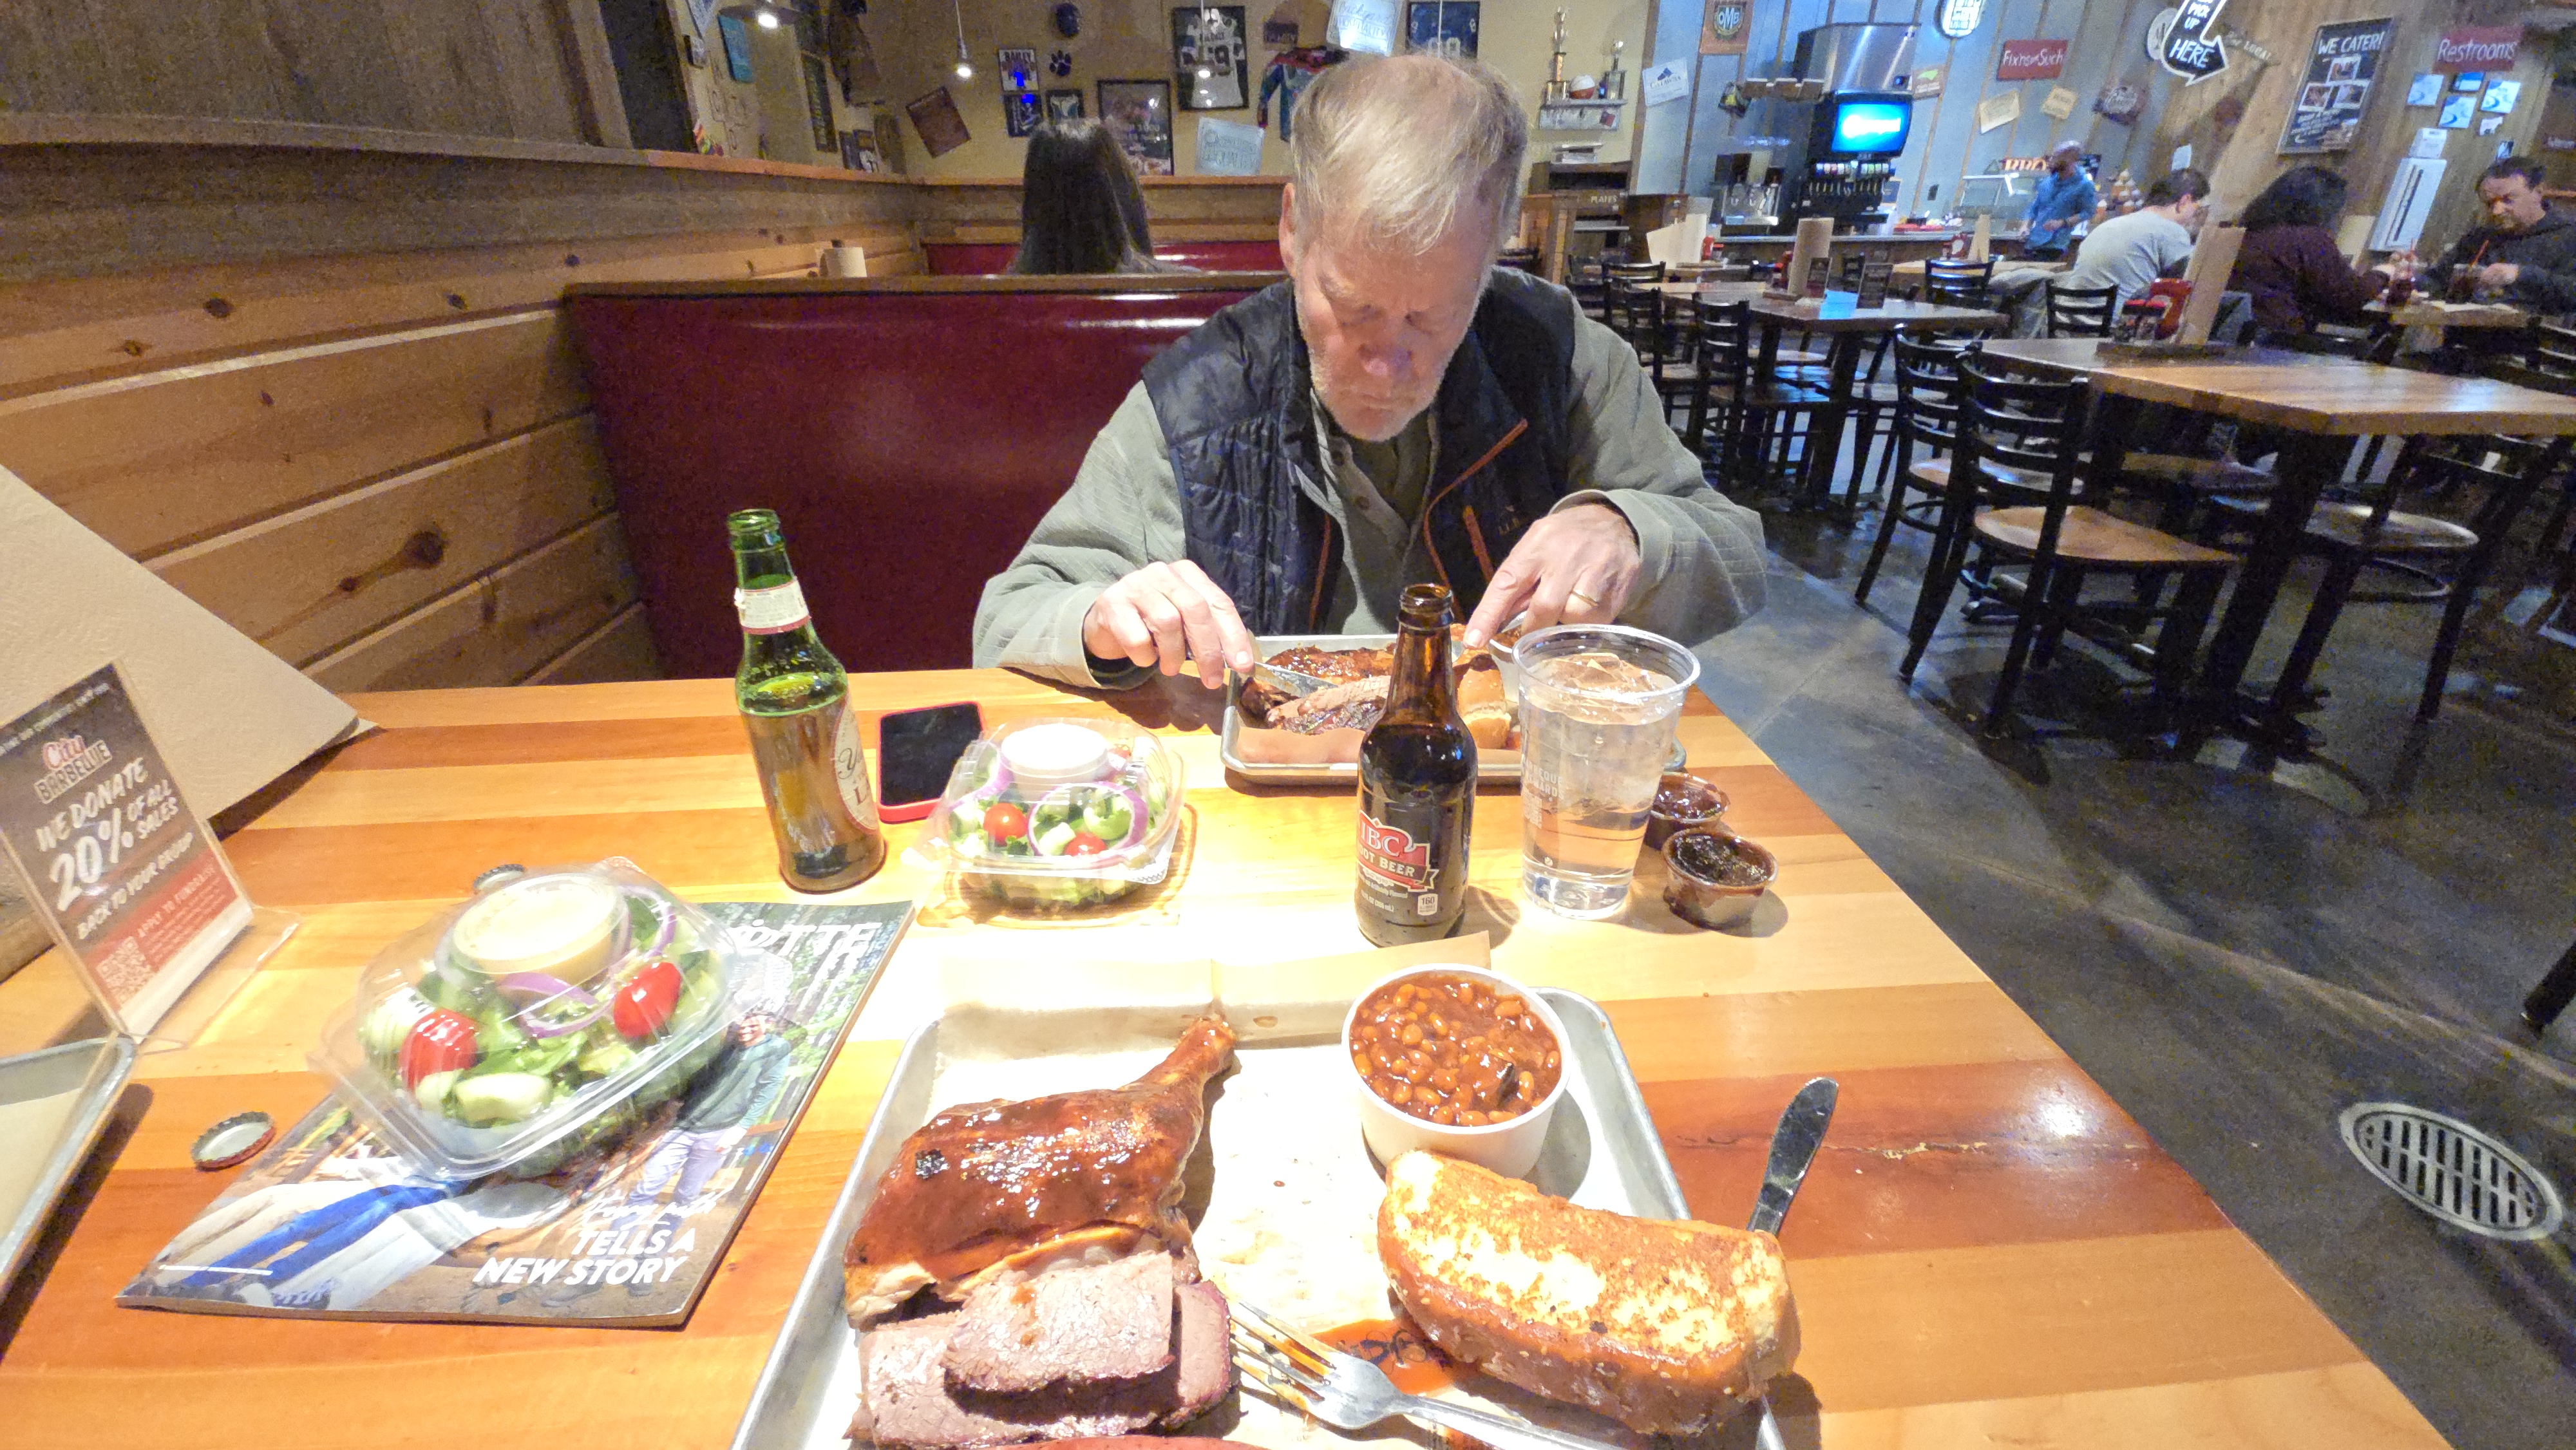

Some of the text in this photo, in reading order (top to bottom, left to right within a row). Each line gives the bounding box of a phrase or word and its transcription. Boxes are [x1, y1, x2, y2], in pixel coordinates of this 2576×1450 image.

[2184, 17, 2201, 30] UP
[2168, 38, 2215, 68] HERE
[2318, 31, 2385, 54] WE CATER!
[2438, 38, 2517, 62] Restrooms
[36, 757, 148, 852] WE DONATE
[127, 779, 173, 822] OF ALL
[136, 796, 180, 840] SALES
[1361, 821, 1399, 856] IBC
[49, 807, 134, 912] 20%
[1358, 845, 1416, 877] OOT BEER
[77, 901, 112, 939] BACK
[110, 888, 127, 909] TO
[126, 862, 159, 896] YOUR
[1421, 896, 1435, 905] 160
[571, 1227, 696, 1256] TELLS A
[472, 1256, 688, 1285] NEW STORY
